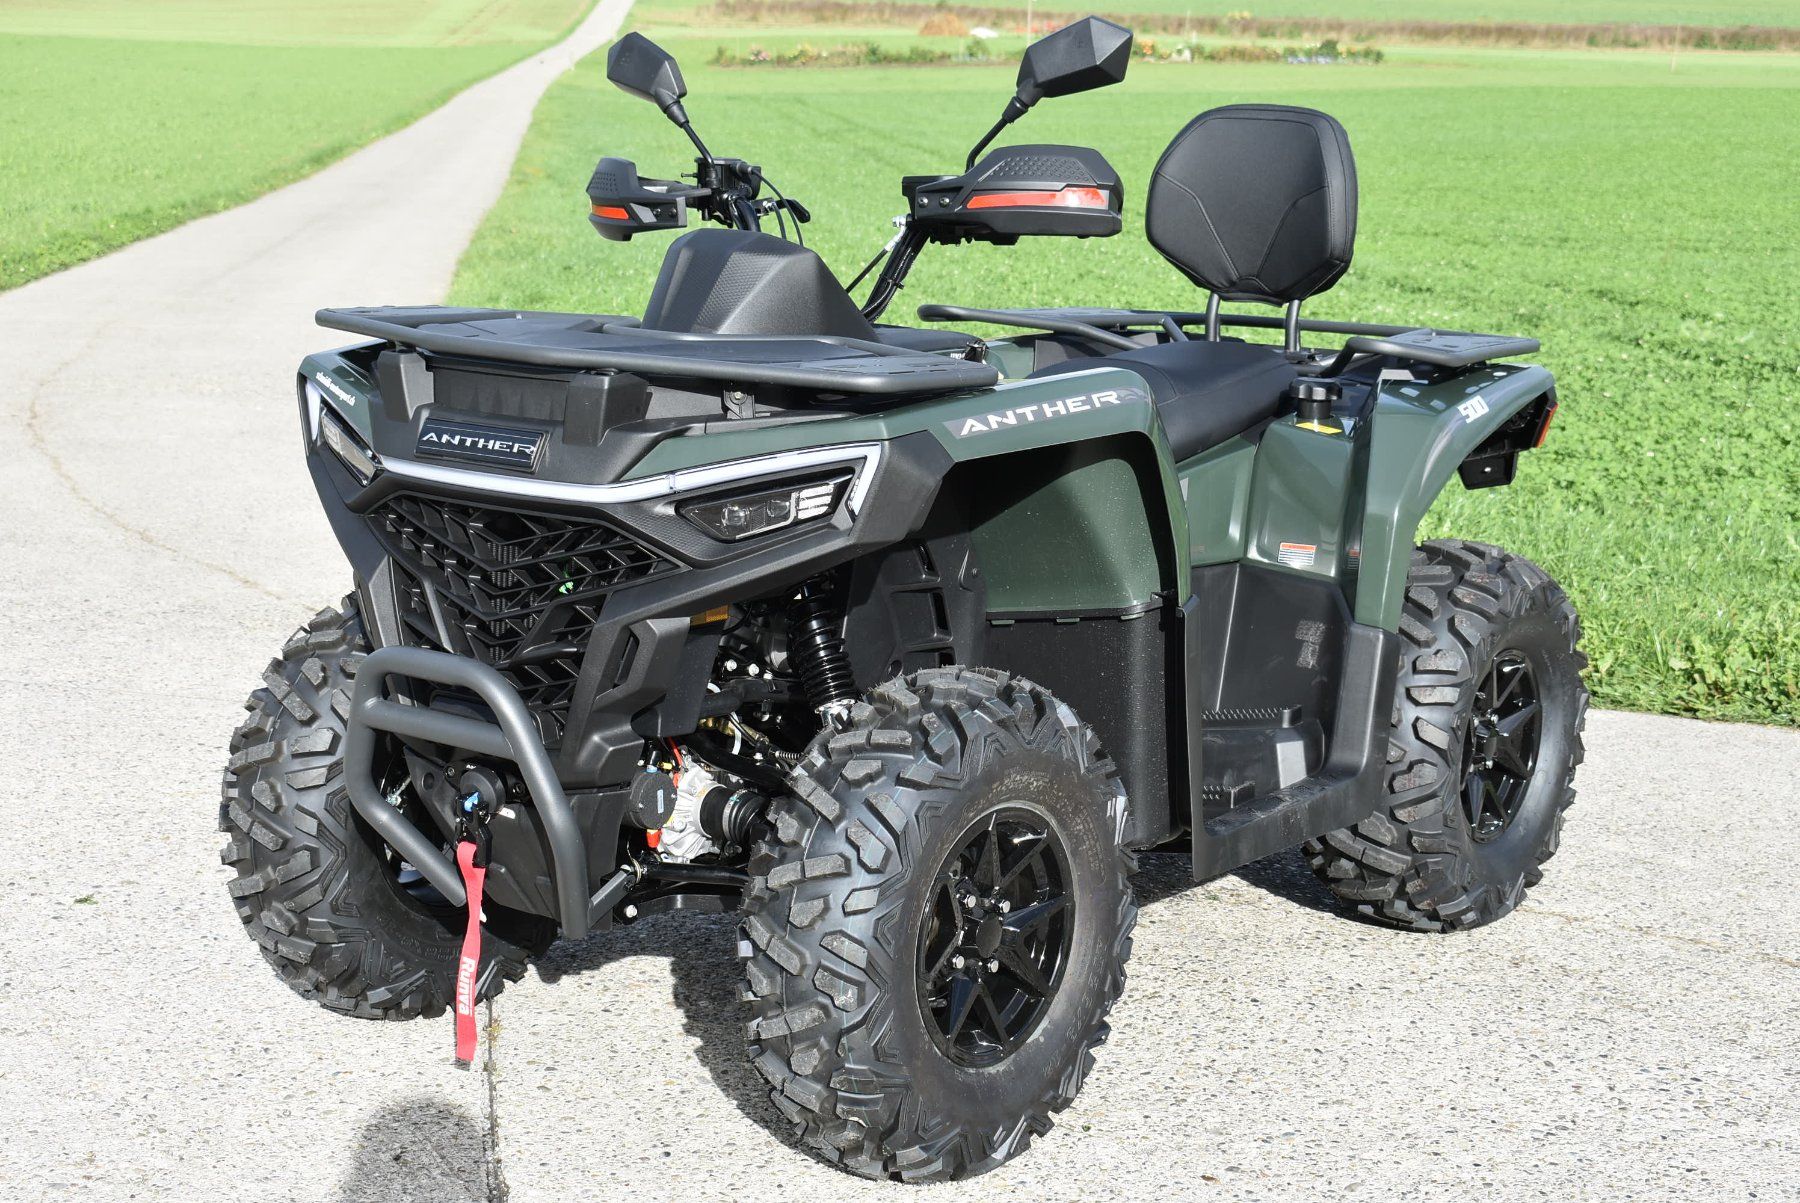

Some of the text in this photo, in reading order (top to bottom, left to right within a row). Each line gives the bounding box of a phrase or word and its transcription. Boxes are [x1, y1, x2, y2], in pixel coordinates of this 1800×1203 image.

[960, 390, 1121, 436] ANTHER
[1457, 395, 1490, 423] 500
[421, 432, 536, 454] ANTHER
[458, 956, 476, 1016] Runva
